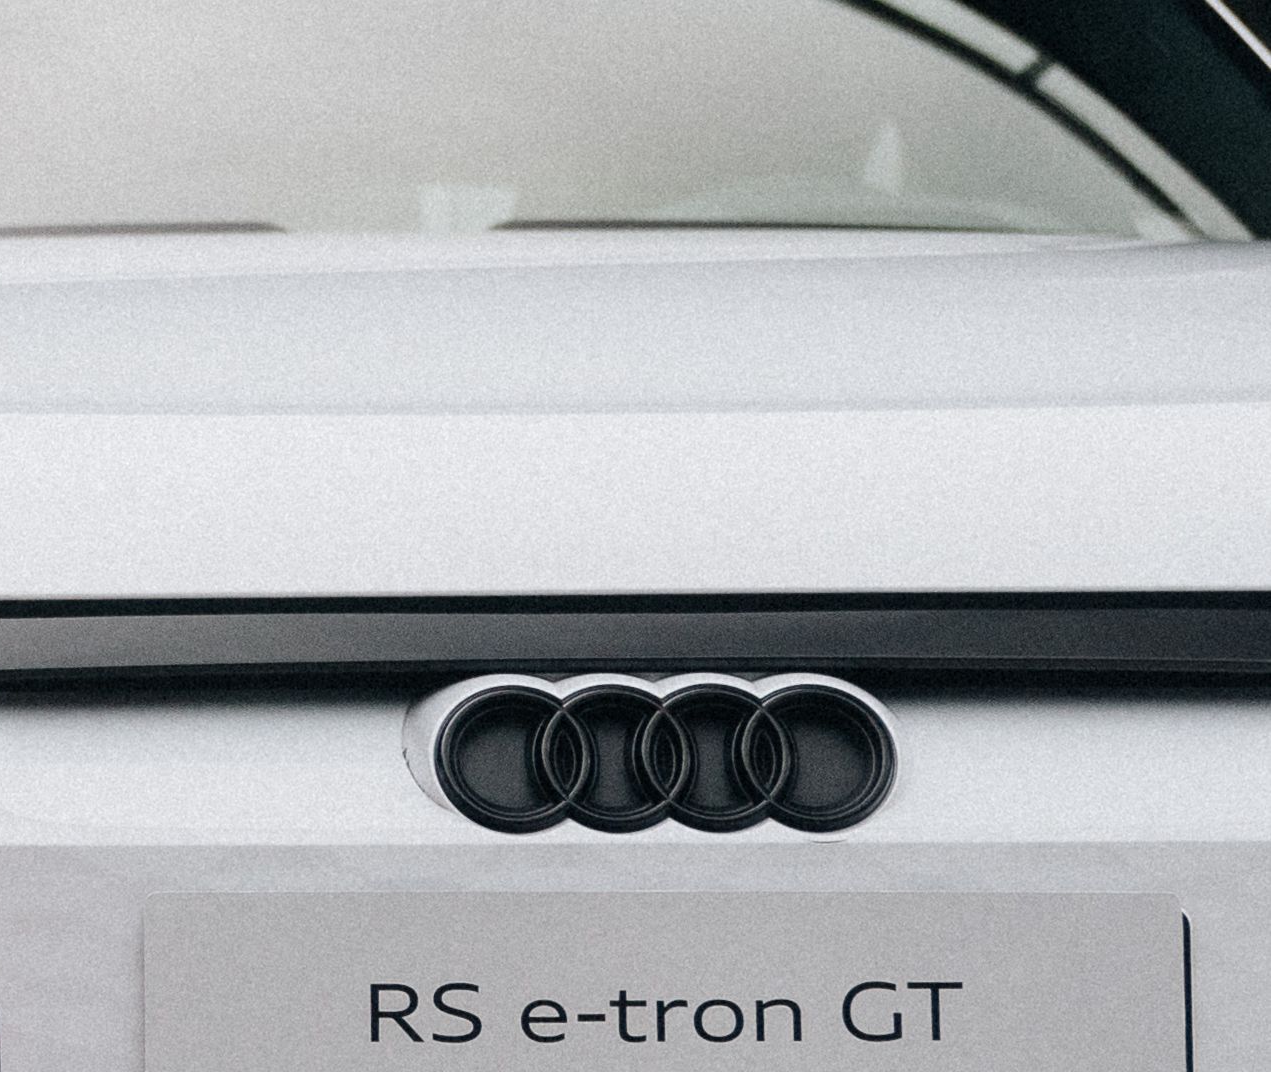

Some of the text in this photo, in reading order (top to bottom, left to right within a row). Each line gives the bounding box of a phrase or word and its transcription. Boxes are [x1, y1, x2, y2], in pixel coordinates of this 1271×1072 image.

[370, 981, 963, 1043] RS e-tron GT
